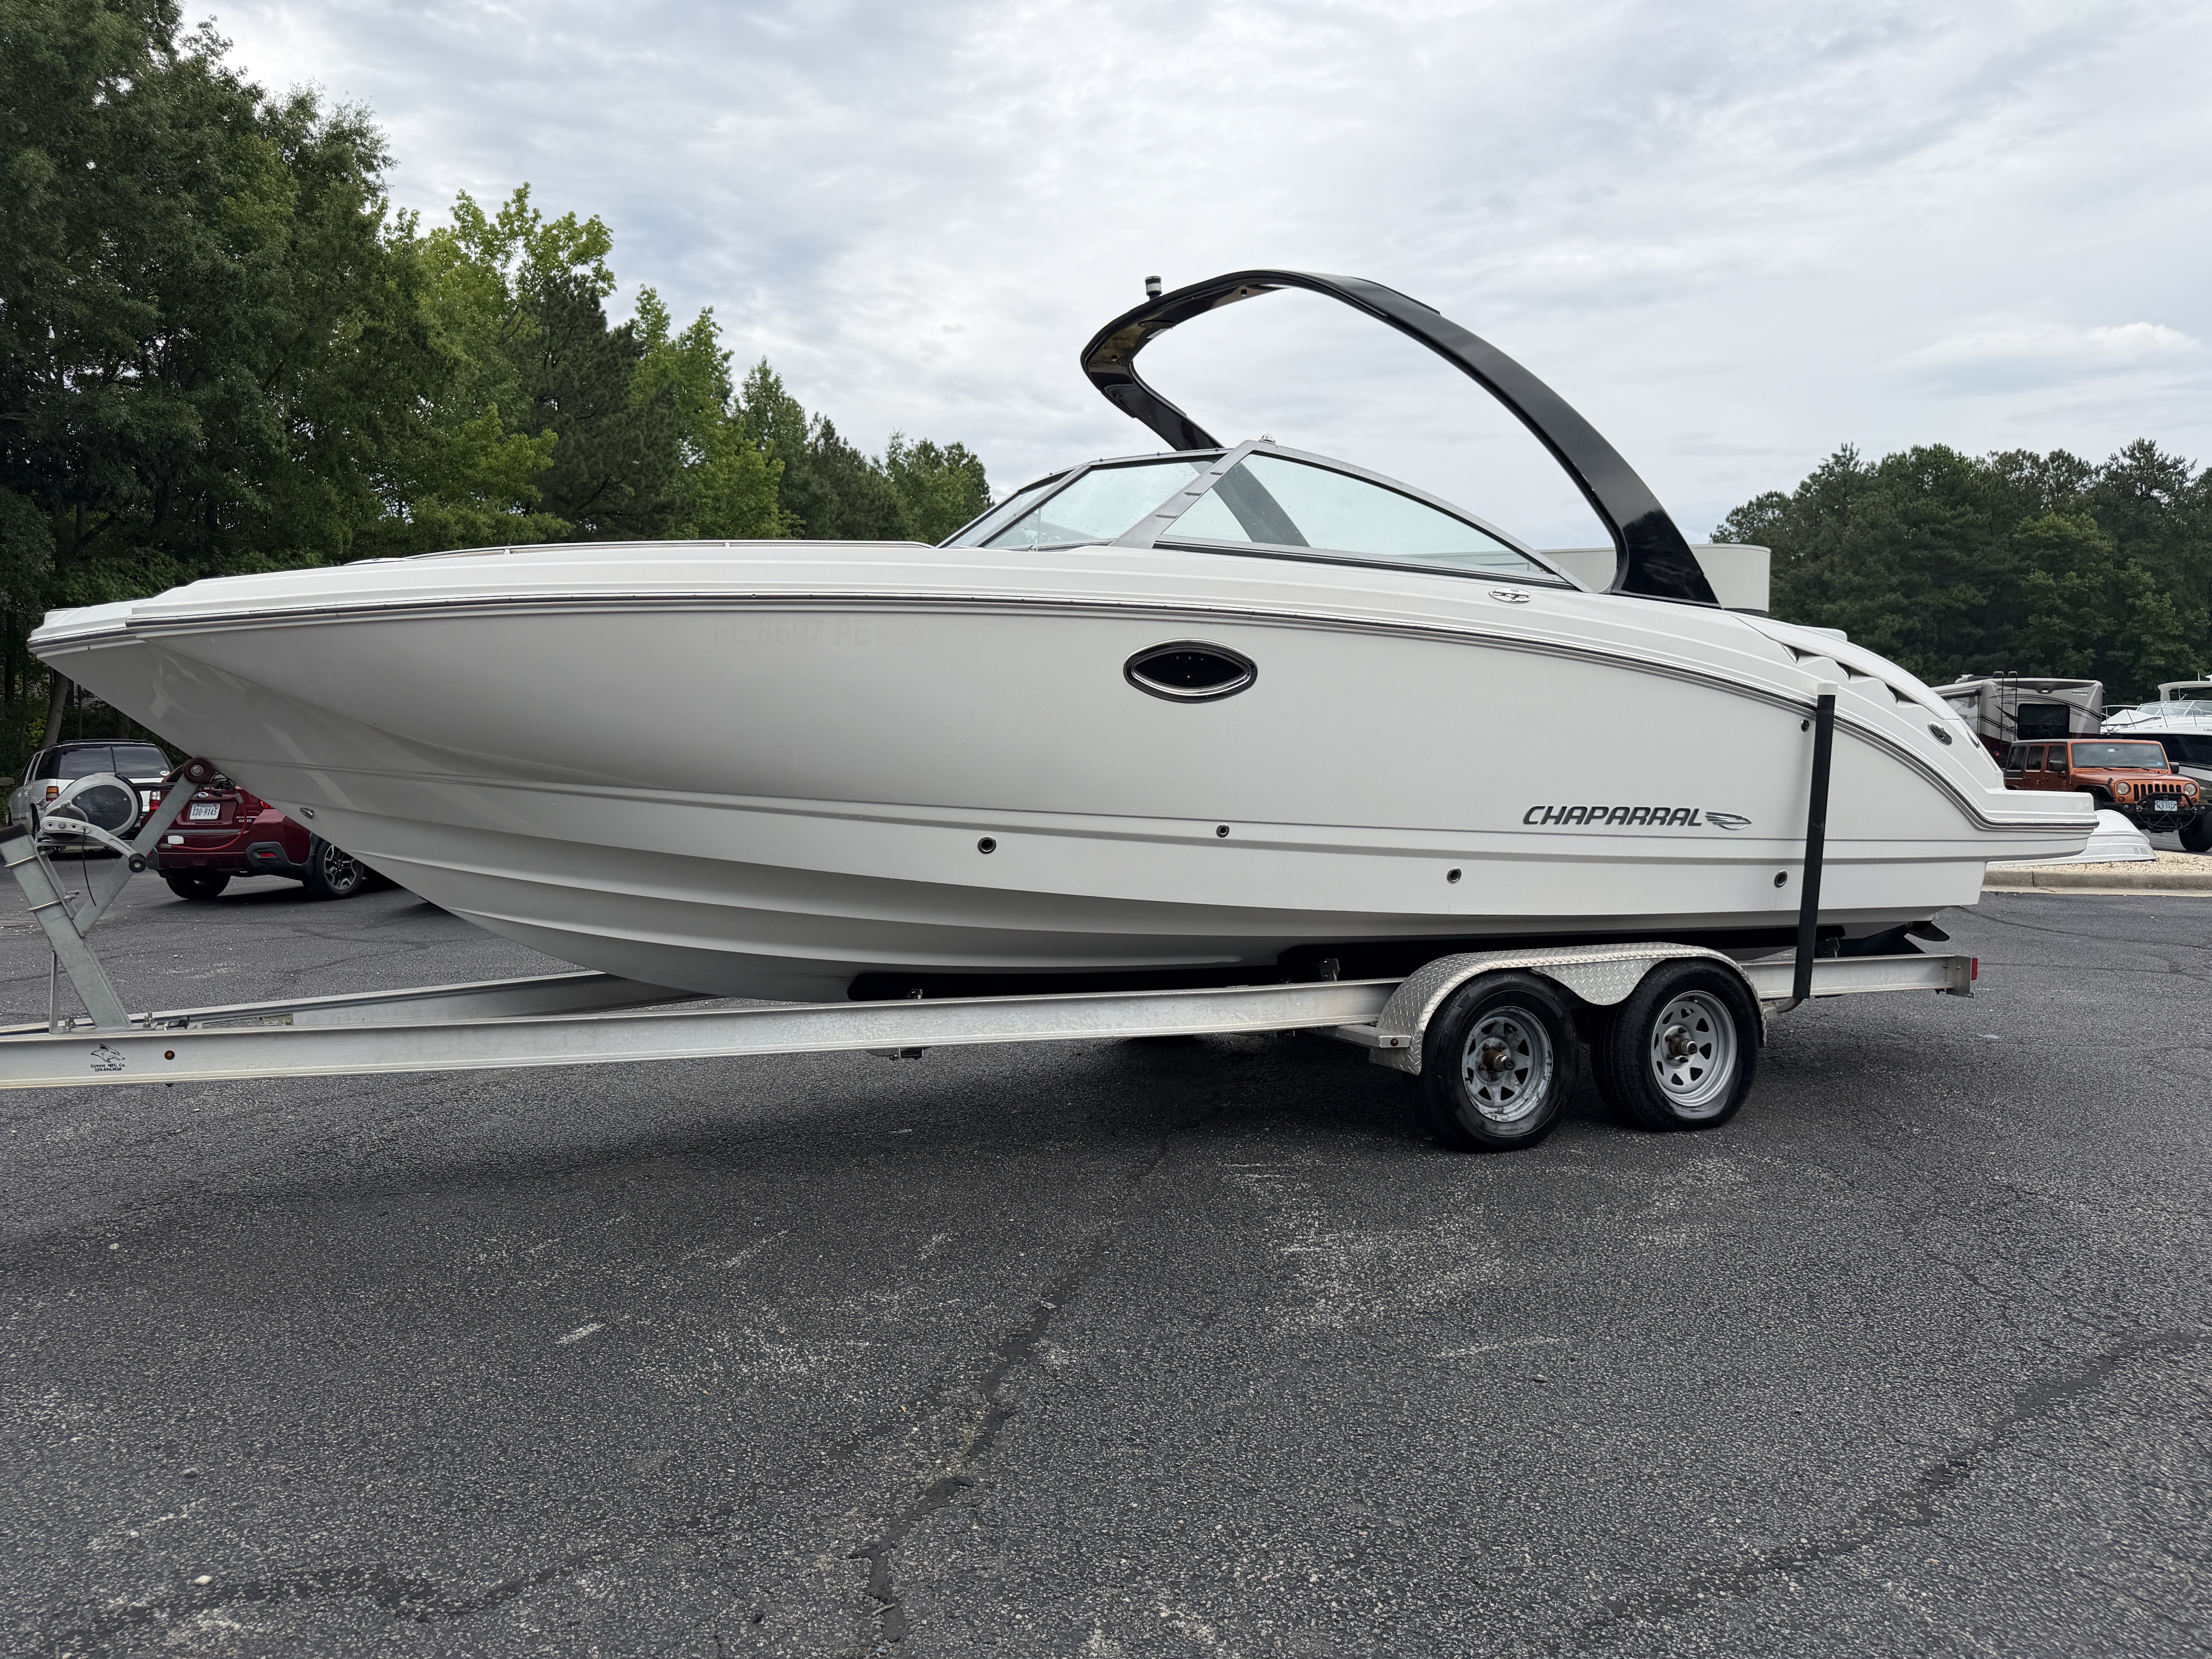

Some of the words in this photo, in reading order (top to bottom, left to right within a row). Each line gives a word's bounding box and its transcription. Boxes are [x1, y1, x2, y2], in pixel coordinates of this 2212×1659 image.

[713, 616, 748, 646] FL
[757, 617, 823, 646] 8697
[835, 617, 871, 646] PE
[1523, 805, 1702, 826] CHAPARRAL
